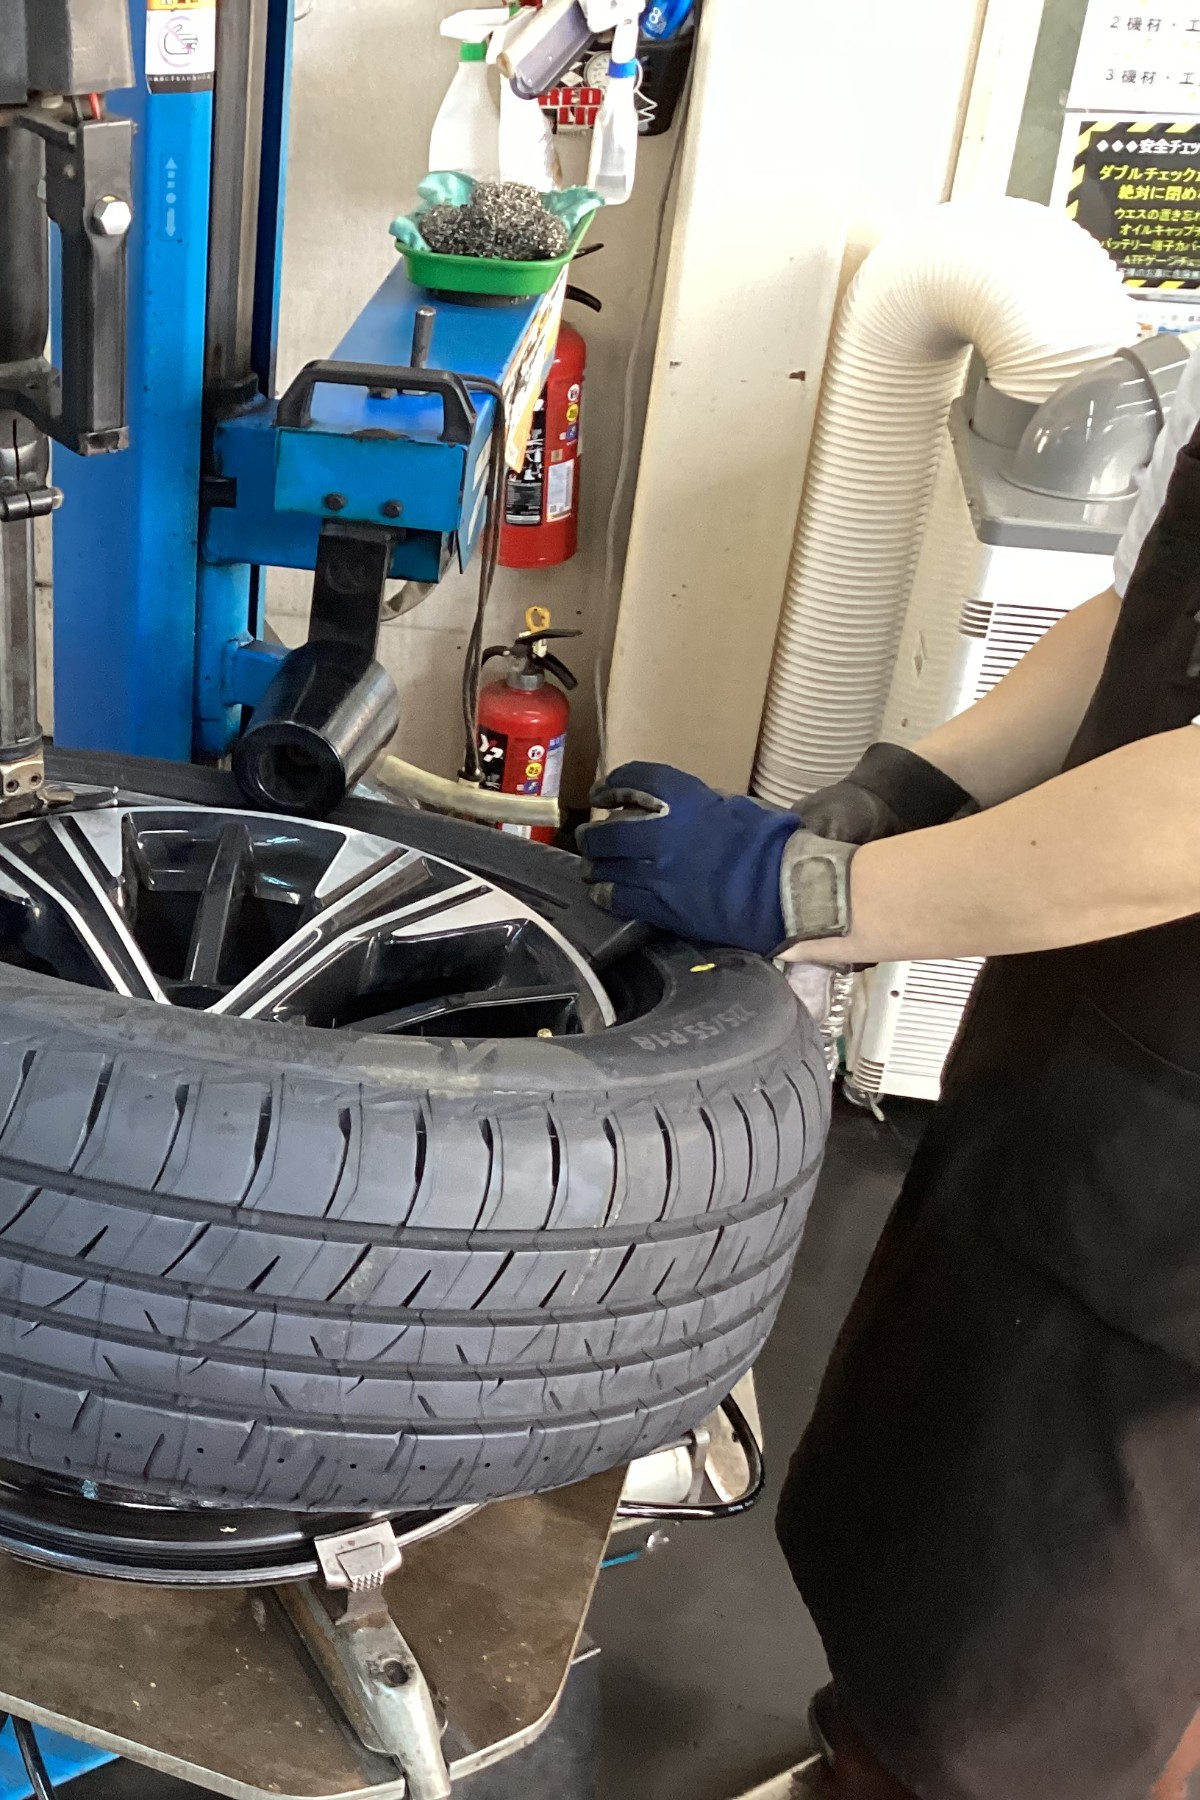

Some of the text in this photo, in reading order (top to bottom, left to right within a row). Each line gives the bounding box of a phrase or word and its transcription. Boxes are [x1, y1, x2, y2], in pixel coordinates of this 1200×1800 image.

[1118, 184, 1200, 201] 絶対に閉め
